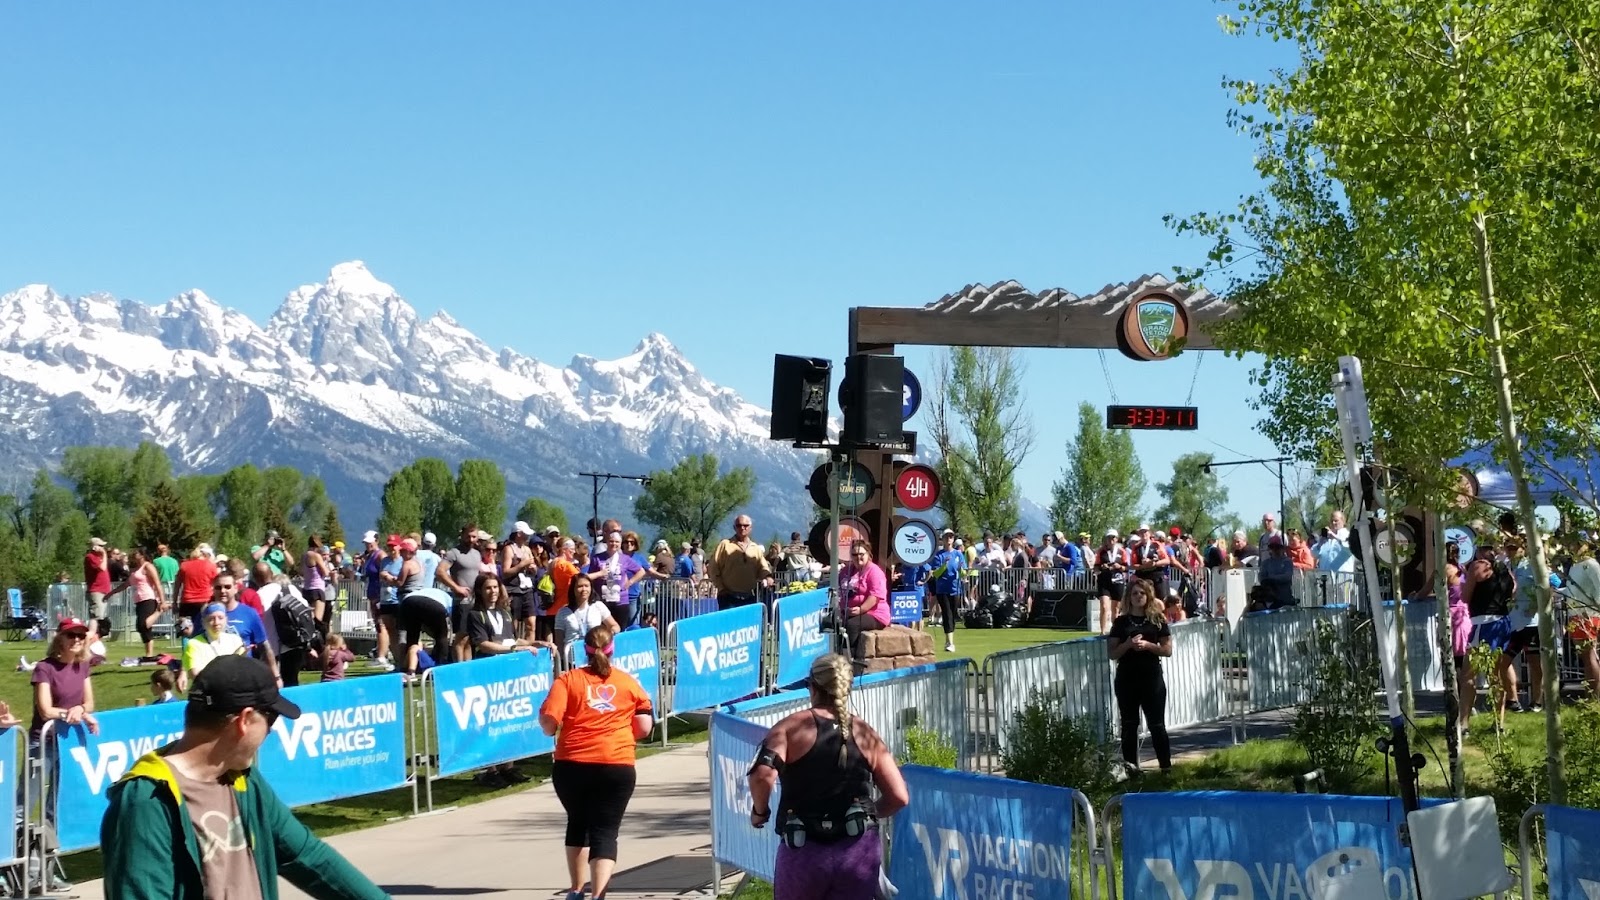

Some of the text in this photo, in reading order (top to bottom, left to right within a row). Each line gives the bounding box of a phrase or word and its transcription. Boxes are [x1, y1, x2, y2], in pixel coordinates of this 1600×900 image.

[1143, 325, 1169, 333] GRAND
[905, 476, 929, 498] 4JH
[894, 600, 918, 609] FOOD
[683, 635, 718, 675] VR
[717, 624, 759, 649] VACATION
[719, 646, 750, 669] RACES
[441, 672, 549, 731] VR VACATION
[487, 697, 533, 724] RACES
[271, 702, 397, 761] VR VACATION
[322, 728, 376, 755] RACES
[69, 741, 128, 795] VR
[325, 749, 390, 770] Run where you play
[911, 822, 1067, 900] VR VACATION
